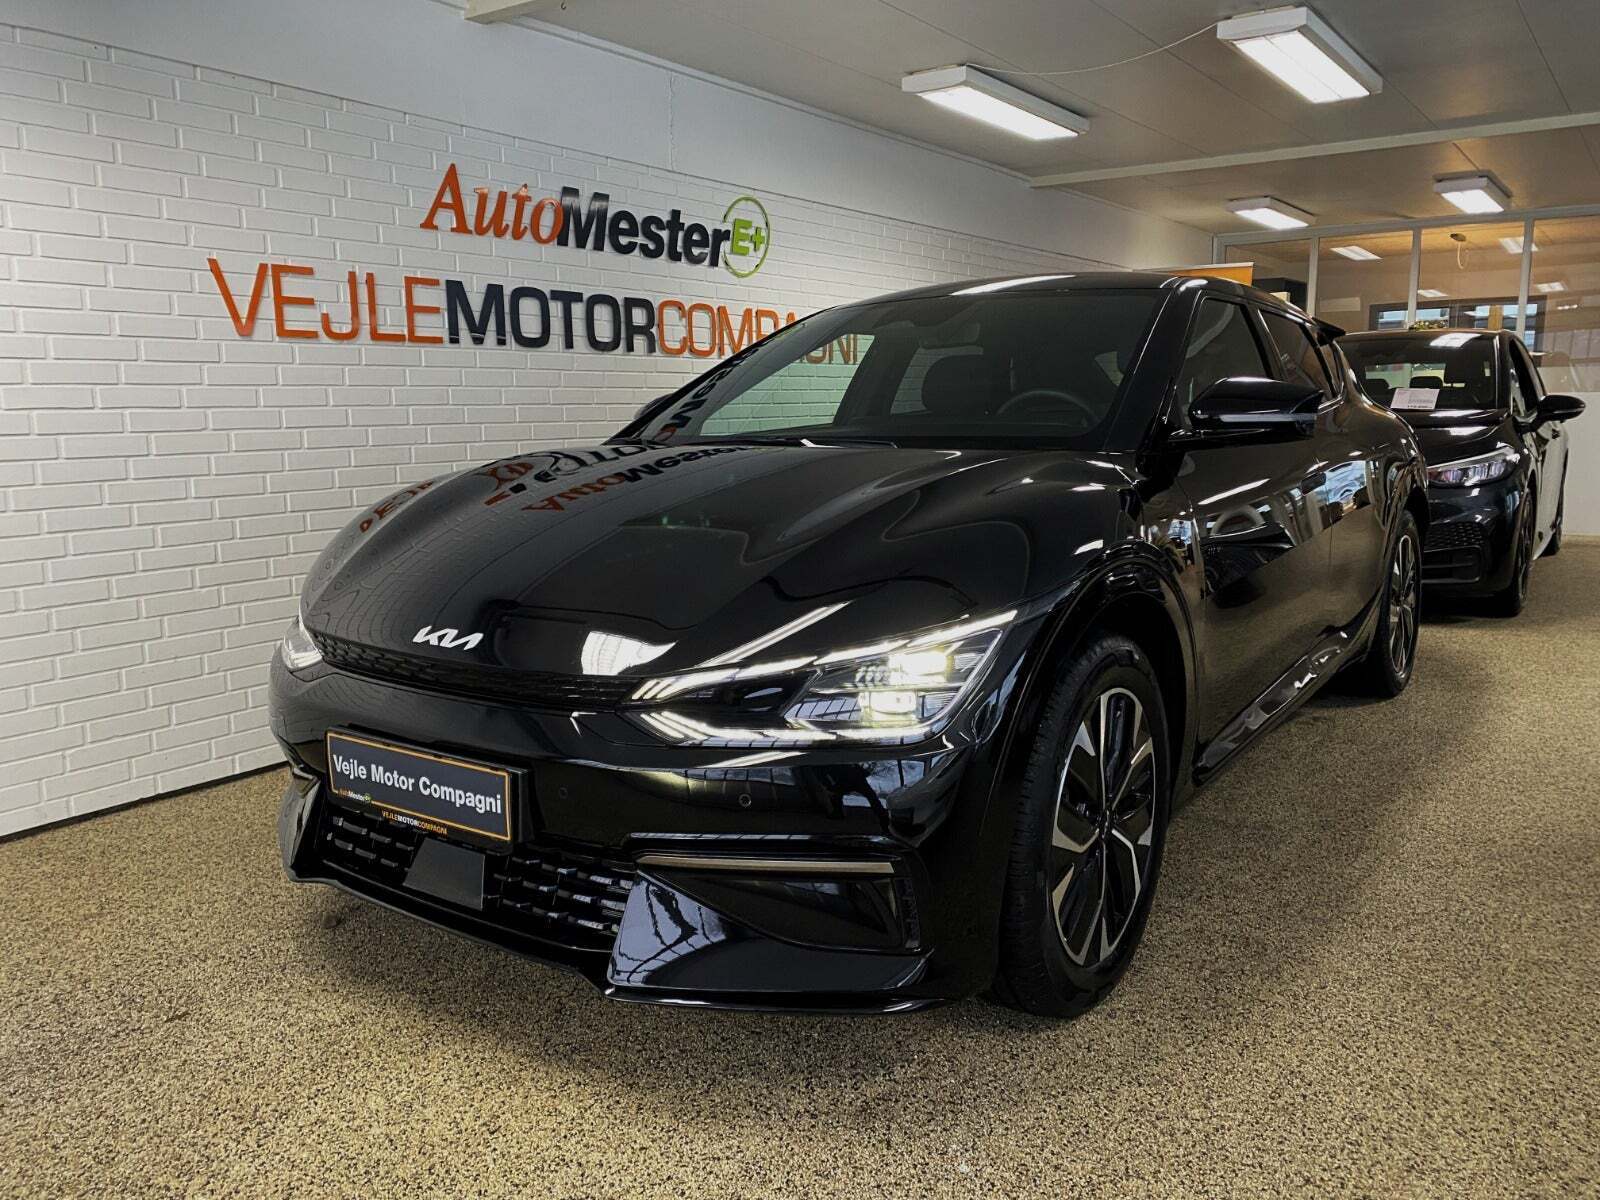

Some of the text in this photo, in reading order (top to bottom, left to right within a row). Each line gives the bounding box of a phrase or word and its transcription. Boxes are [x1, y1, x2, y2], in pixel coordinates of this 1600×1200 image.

[420, 163, 766, 267] AutoMester E+
[332, 754, 501, 814] Vejle Motor Compagni
